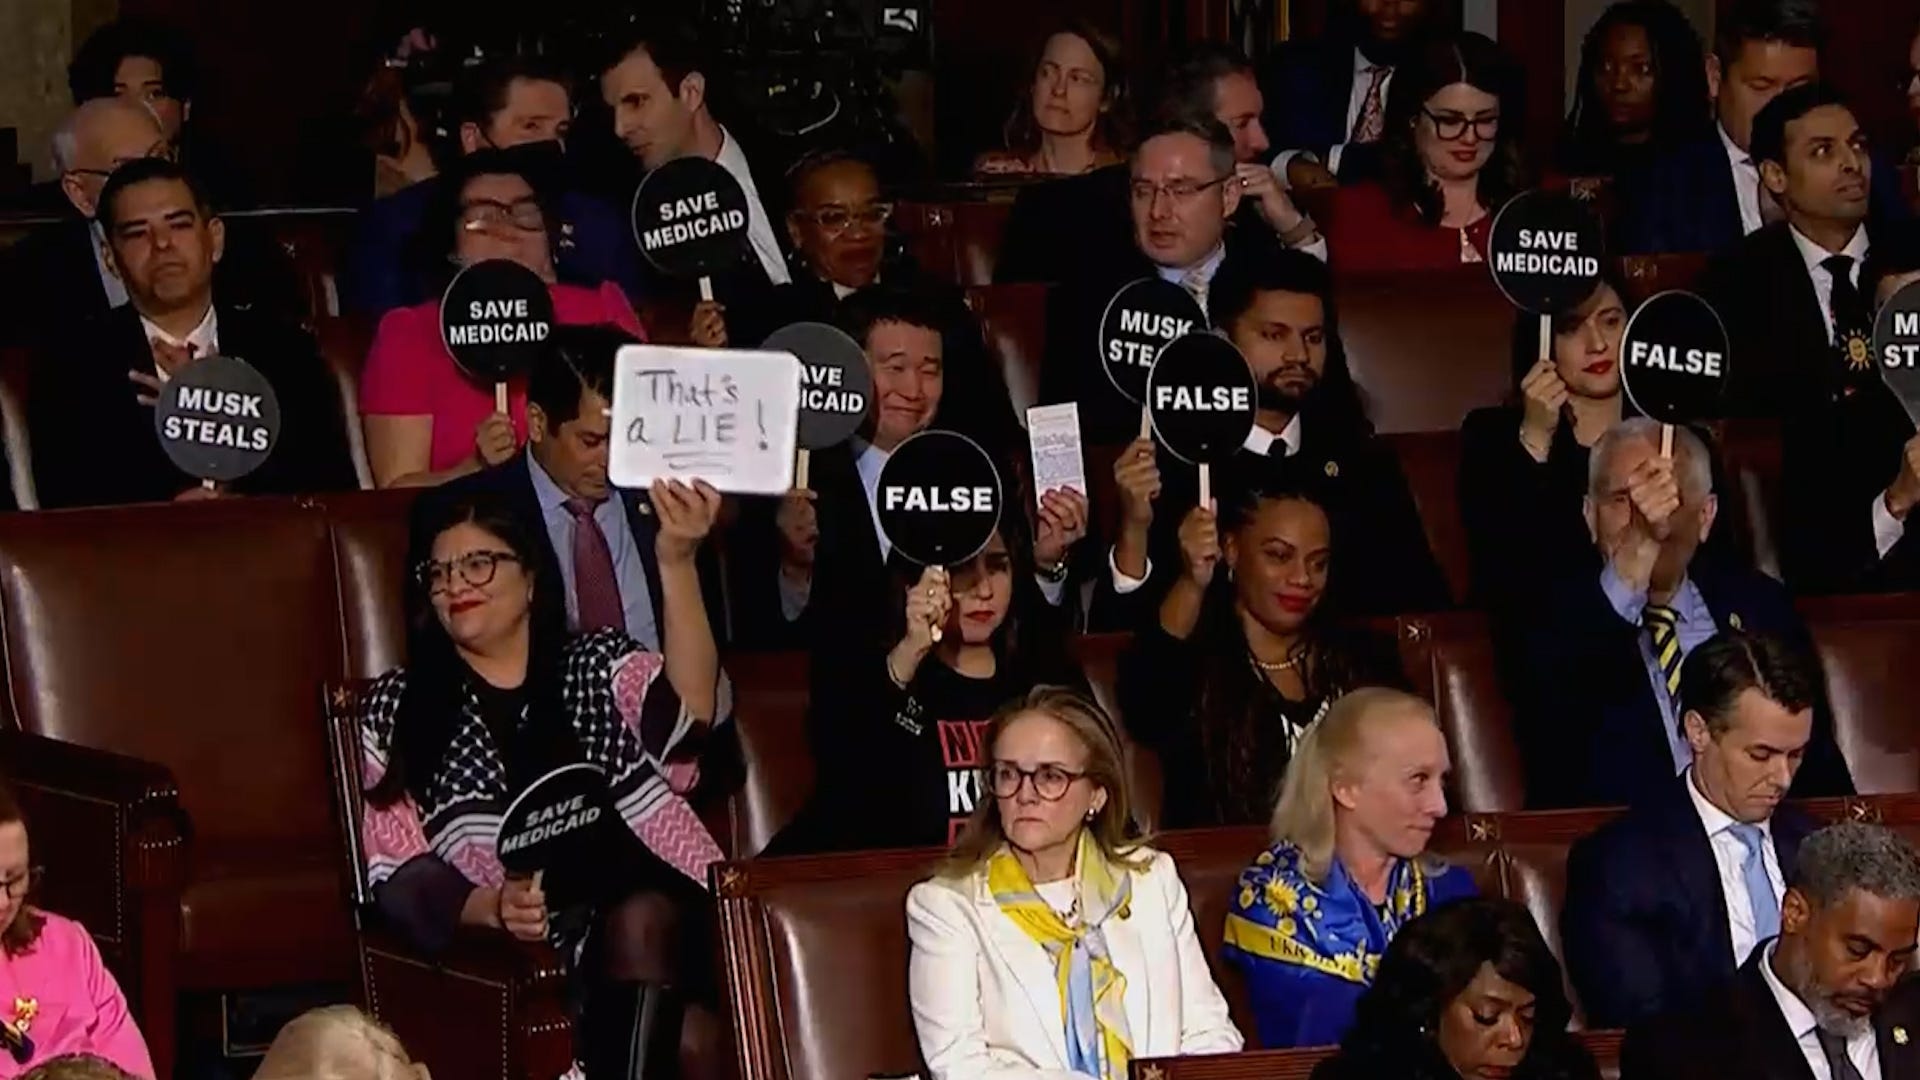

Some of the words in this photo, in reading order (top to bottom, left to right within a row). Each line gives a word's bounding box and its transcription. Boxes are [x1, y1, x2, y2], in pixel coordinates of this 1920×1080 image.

[659, 191, 719, 221] SAVE
[643, 209, 745, 250] MEDICAID
[1519, 229, 1579, 250] SAVE
[1497, 252, 1599, 276] MEDICAID
[469, 299, 529, 319] SAVE
[1120, 308, 1193, 339] MUSK
[449, 322, 550, 345] MEDICAID
[1108, 338, 1154, 368] STE
[1630, 340, 1723, 377] FALSE
[637, 369, 738, 408] That's
[800, 364, 843, 387] AVE
[178, 386, 261, 418] MUSK
[801, 388, 865, 413] ICAID
[1156, 386, 1250, 411] FALSE
[164, 416, 269, 450] STEALS
[627, 416, 648, 444] a
[885, 486, 993, 512] FALSE
[525, 794, 586, 828] SAVE
[501, 807, 601, 855] MEDICAID
